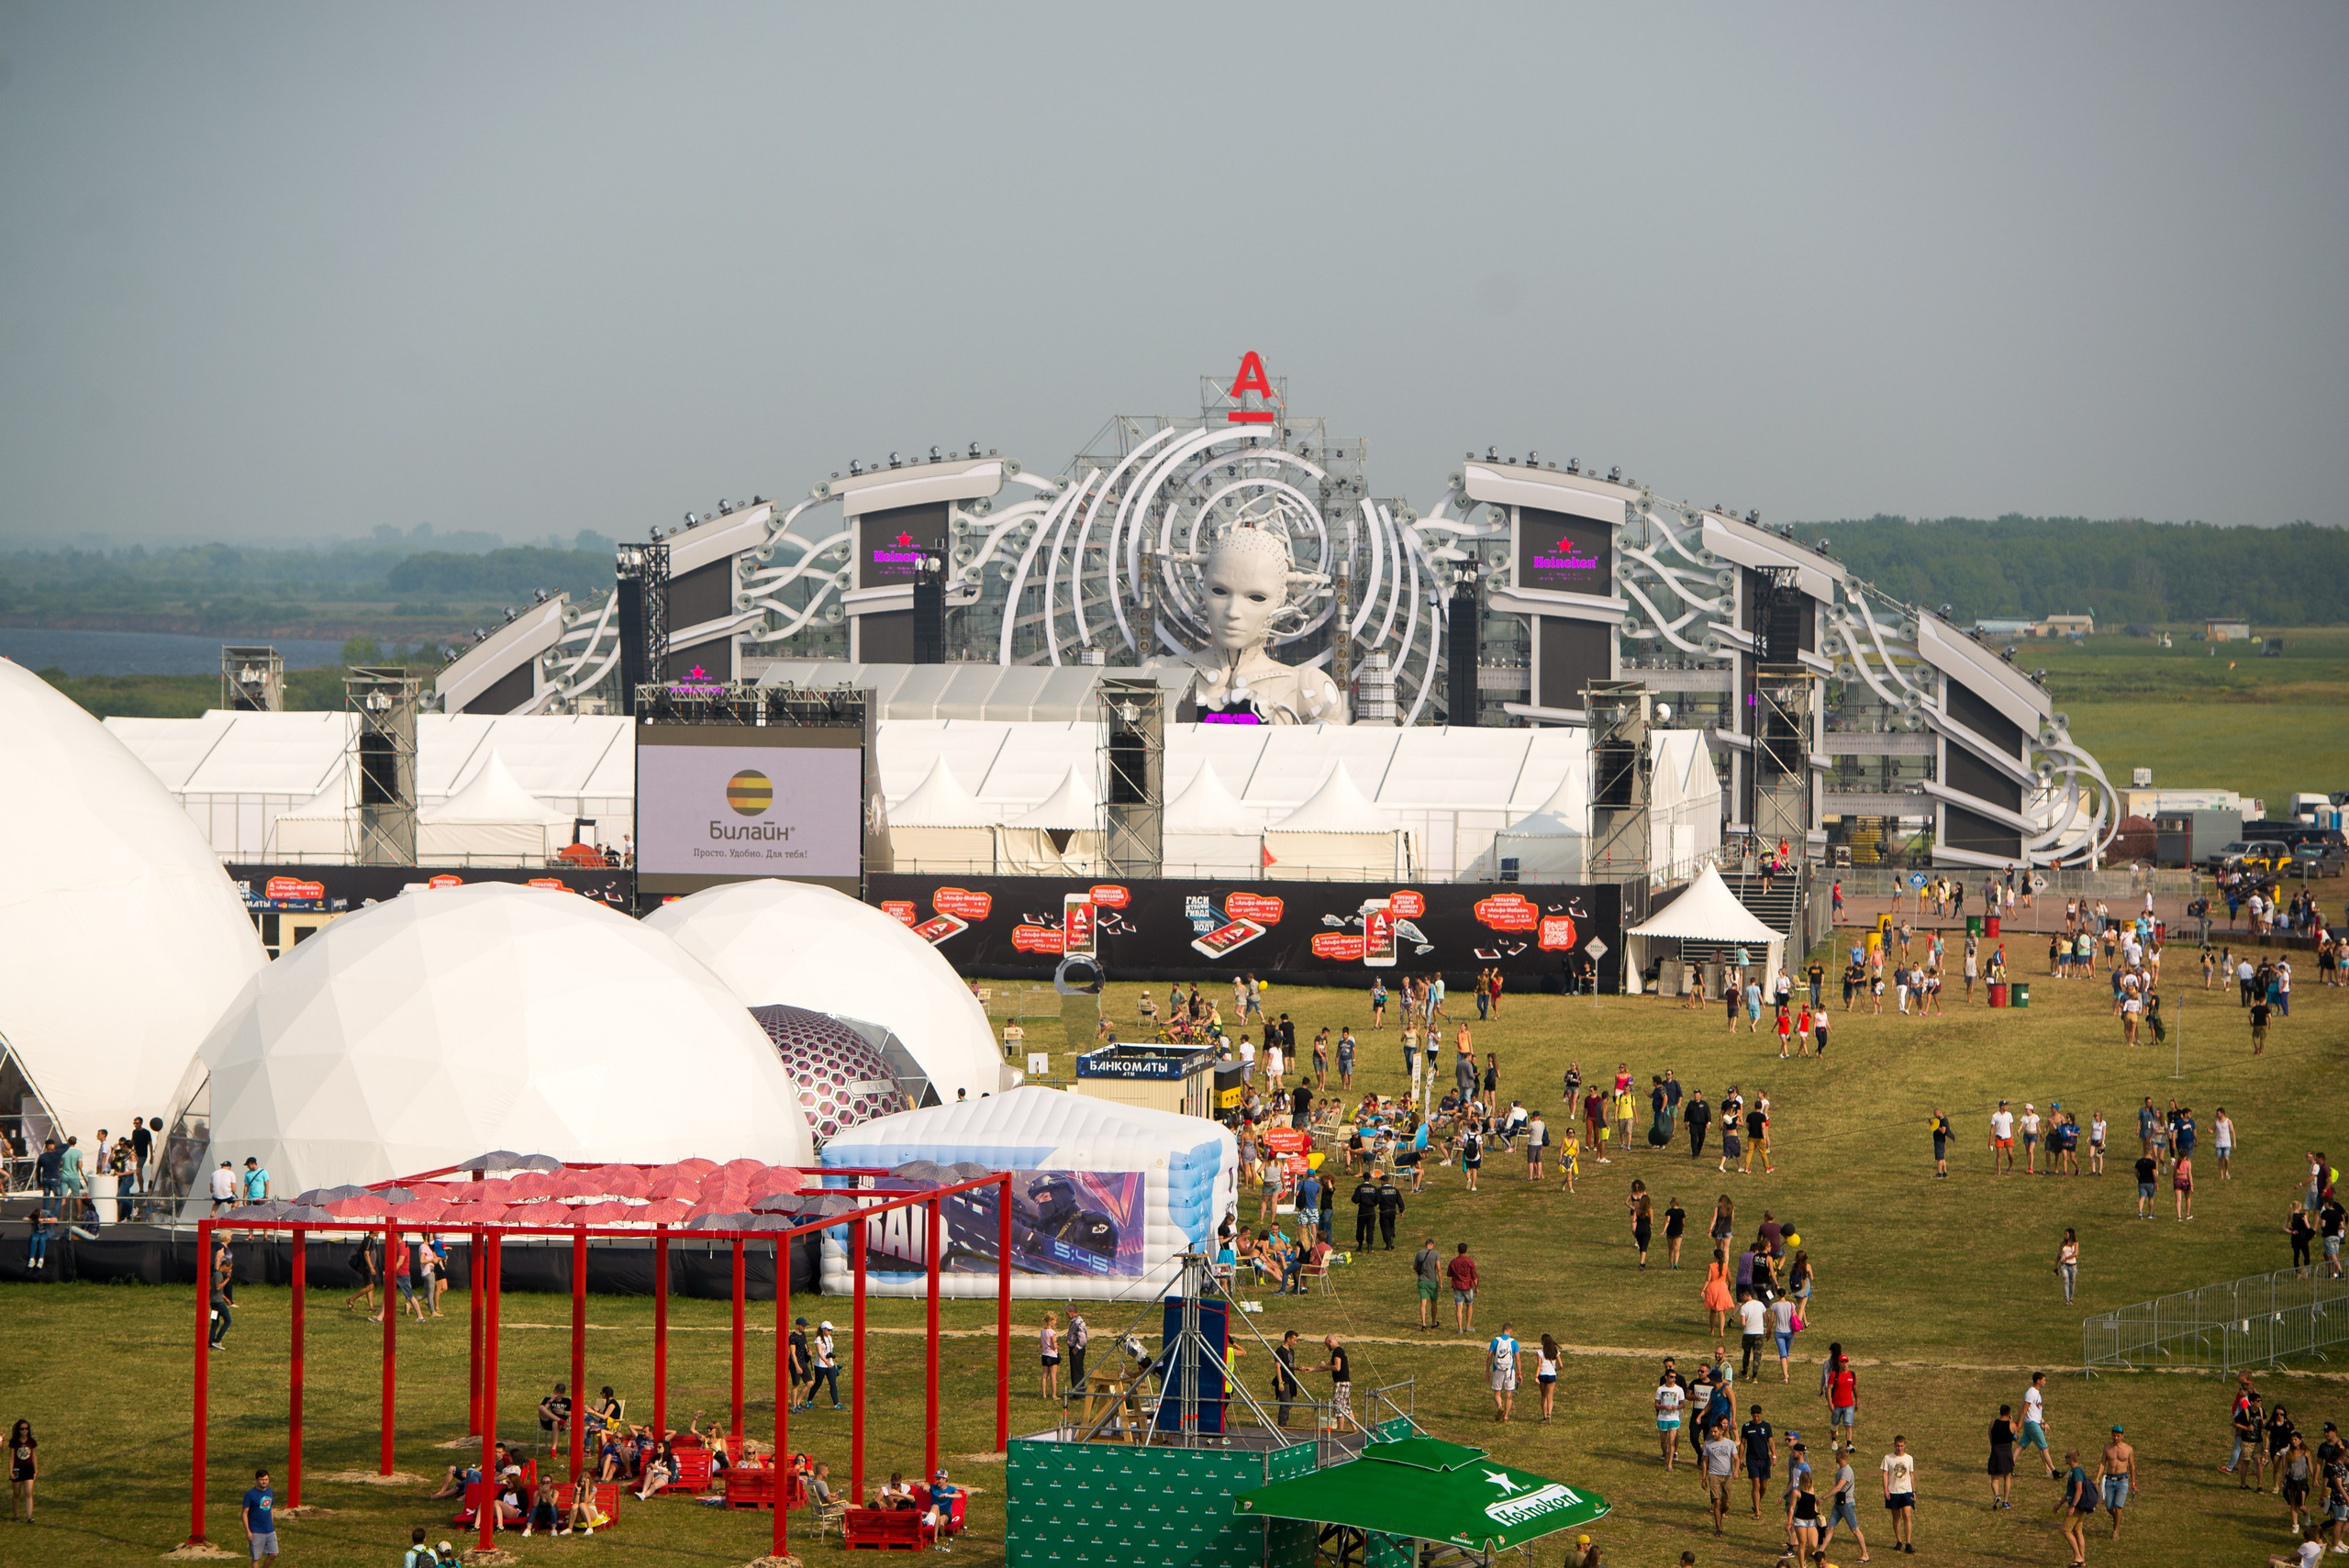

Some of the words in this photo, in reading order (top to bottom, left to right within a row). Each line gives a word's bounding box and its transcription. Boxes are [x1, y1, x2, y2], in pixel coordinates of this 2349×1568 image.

[874, 550, 928, 562] Heinek
[1533, 555, 1597, 569] Heineken
[709, 820, 789, 840] Билайн
[694, 848, 727, 860] Просто.
[729, 849, 763, 860] Удобно.
[766, 850, 783, 860] Для
[785, 850, 807, 859] тебя!
[1186, 895, 1209, 905] ГАСИ
[1089, 1060, 1168, 1073] БАНКОМАТЫ
[1494, 1494, 1577, 1527] Heineken
